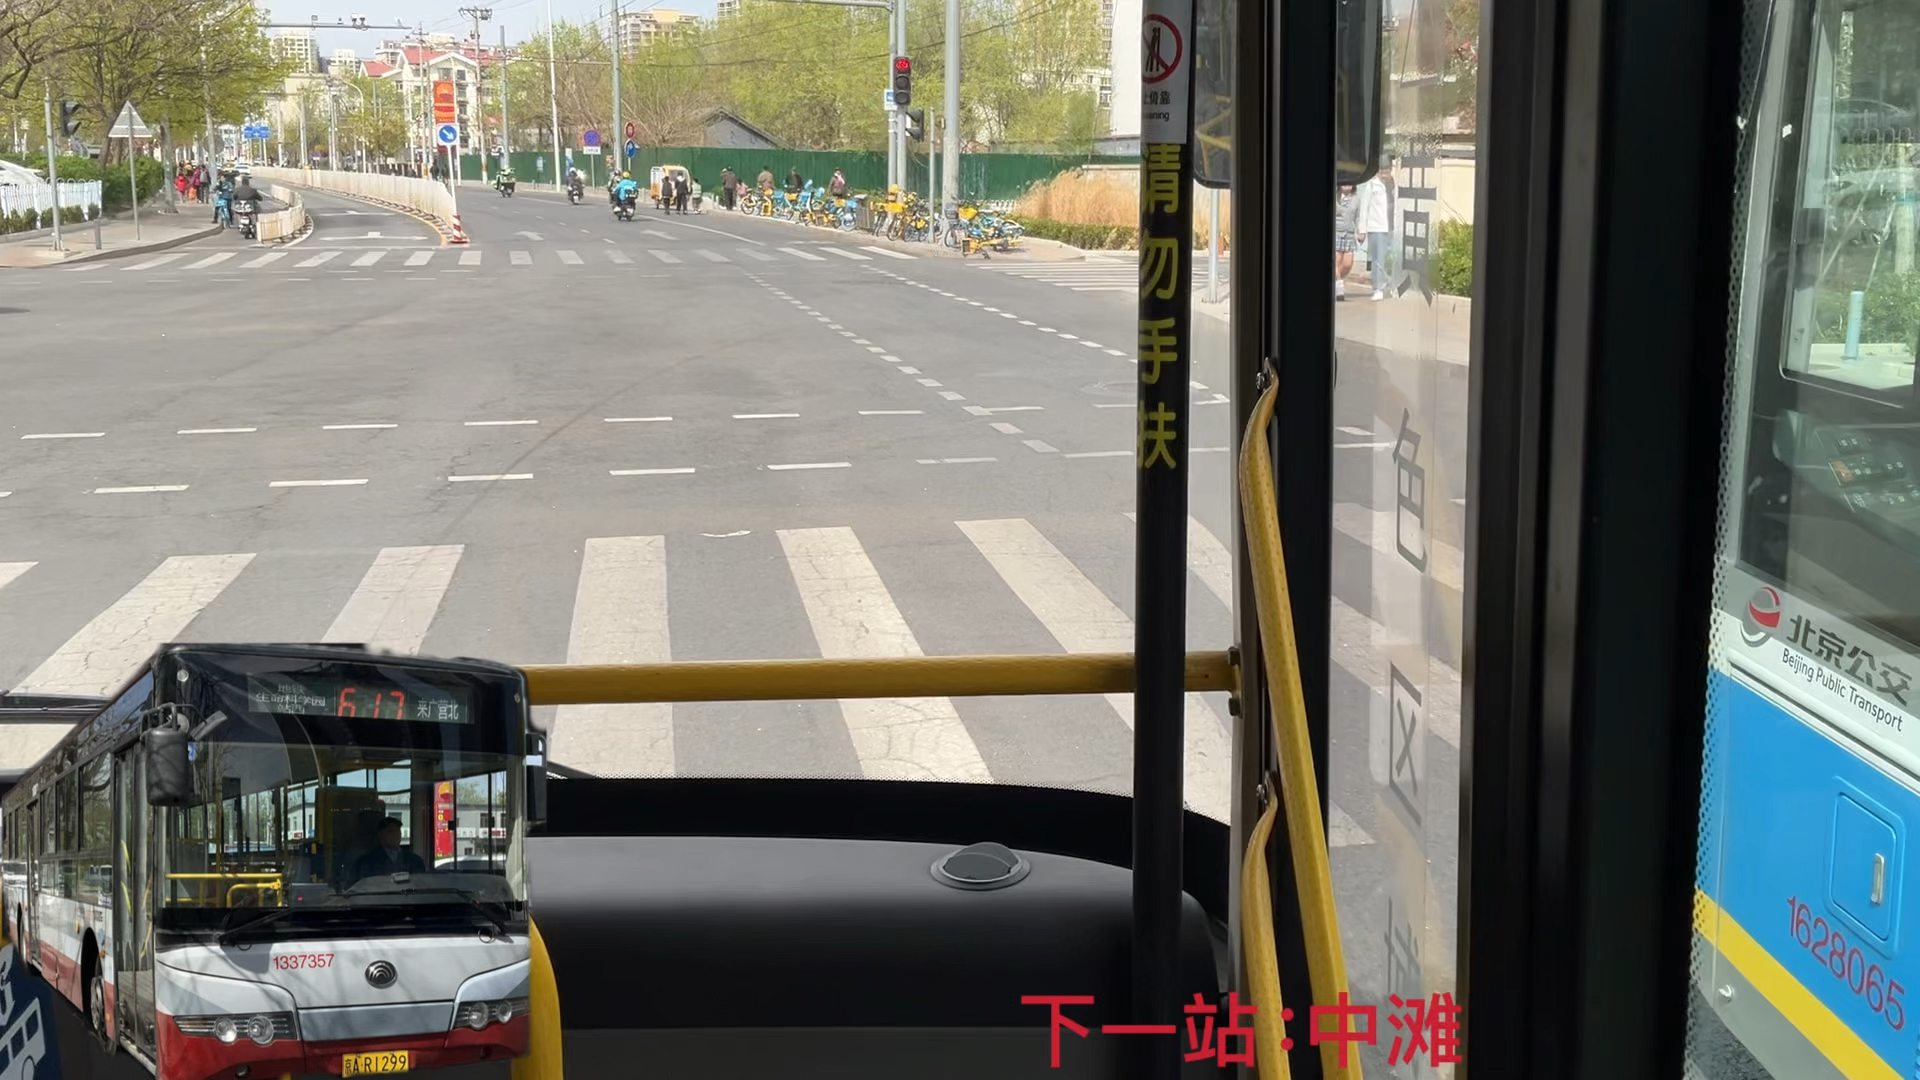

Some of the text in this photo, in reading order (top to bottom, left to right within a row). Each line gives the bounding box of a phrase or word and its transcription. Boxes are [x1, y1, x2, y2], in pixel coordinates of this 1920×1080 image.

[1137, 143, 1182, 470] 请勿手扶
[1782, 647, 1904, 732] Beijing Public Transport
[1786, 614, 1913, 707] 北京公交
[337, 687, 405, 720] 617
[416, 698, 460, 721] 来广营北
[273, 953, 335, 970] 1337357
[1787, 896, 1905, 1031] 1628065
